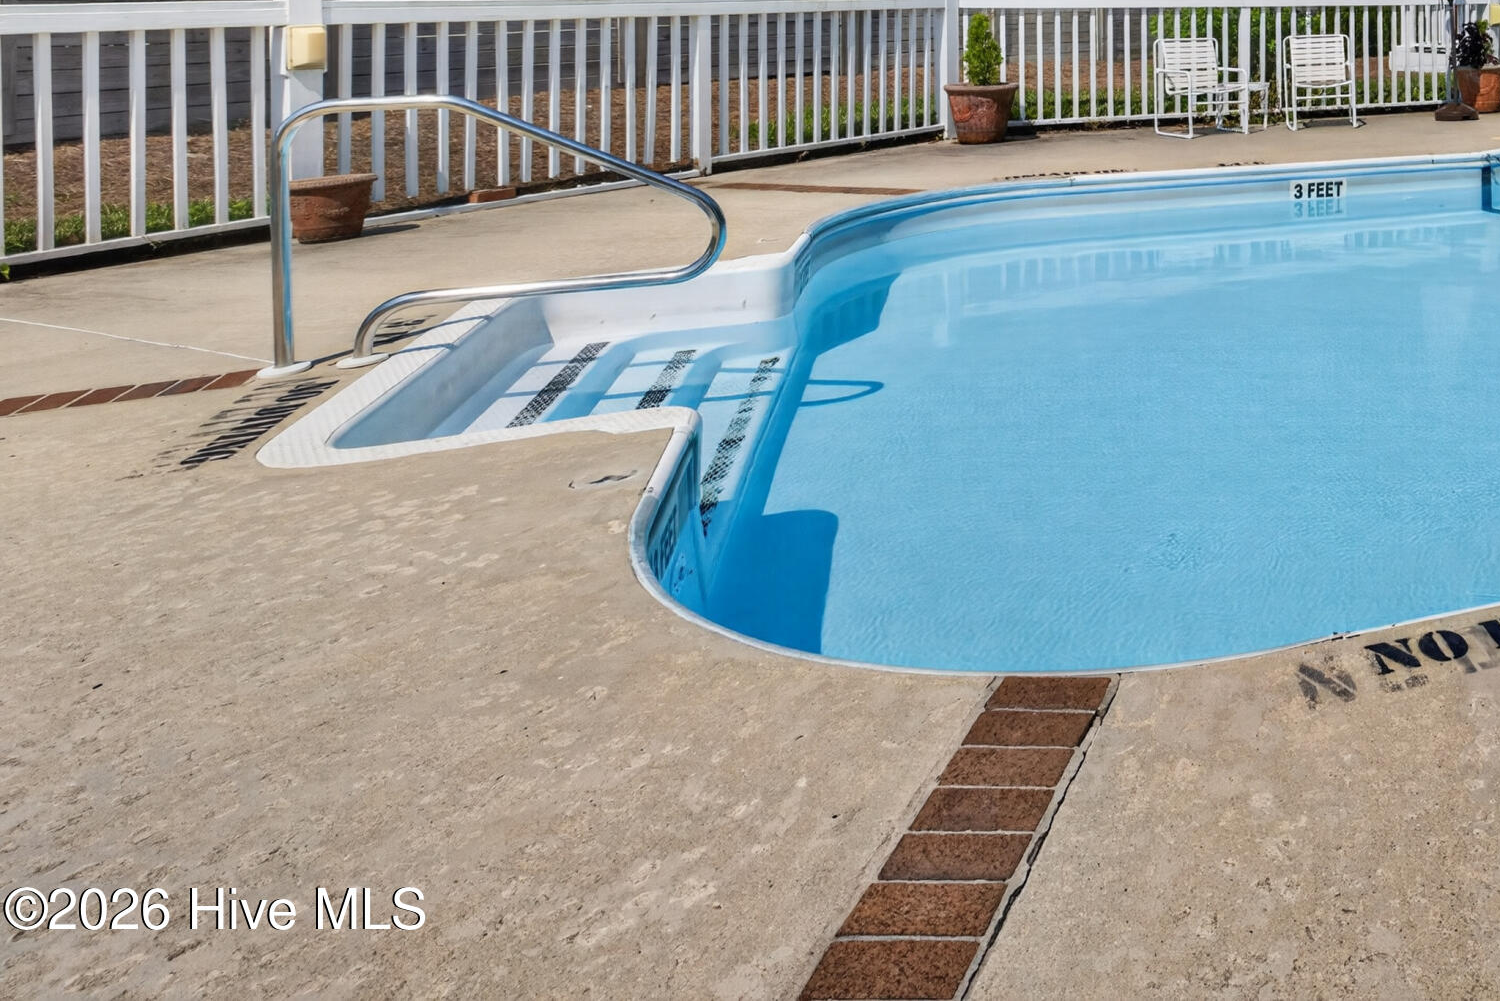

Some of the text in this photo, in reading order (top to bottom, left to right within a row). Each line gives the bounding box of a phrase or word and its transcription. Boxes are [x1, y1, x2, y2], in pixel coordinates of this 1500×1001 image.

[1294, 181, 1343, 199] 3 FEET
[1364, 629, 1469, 676] NO
